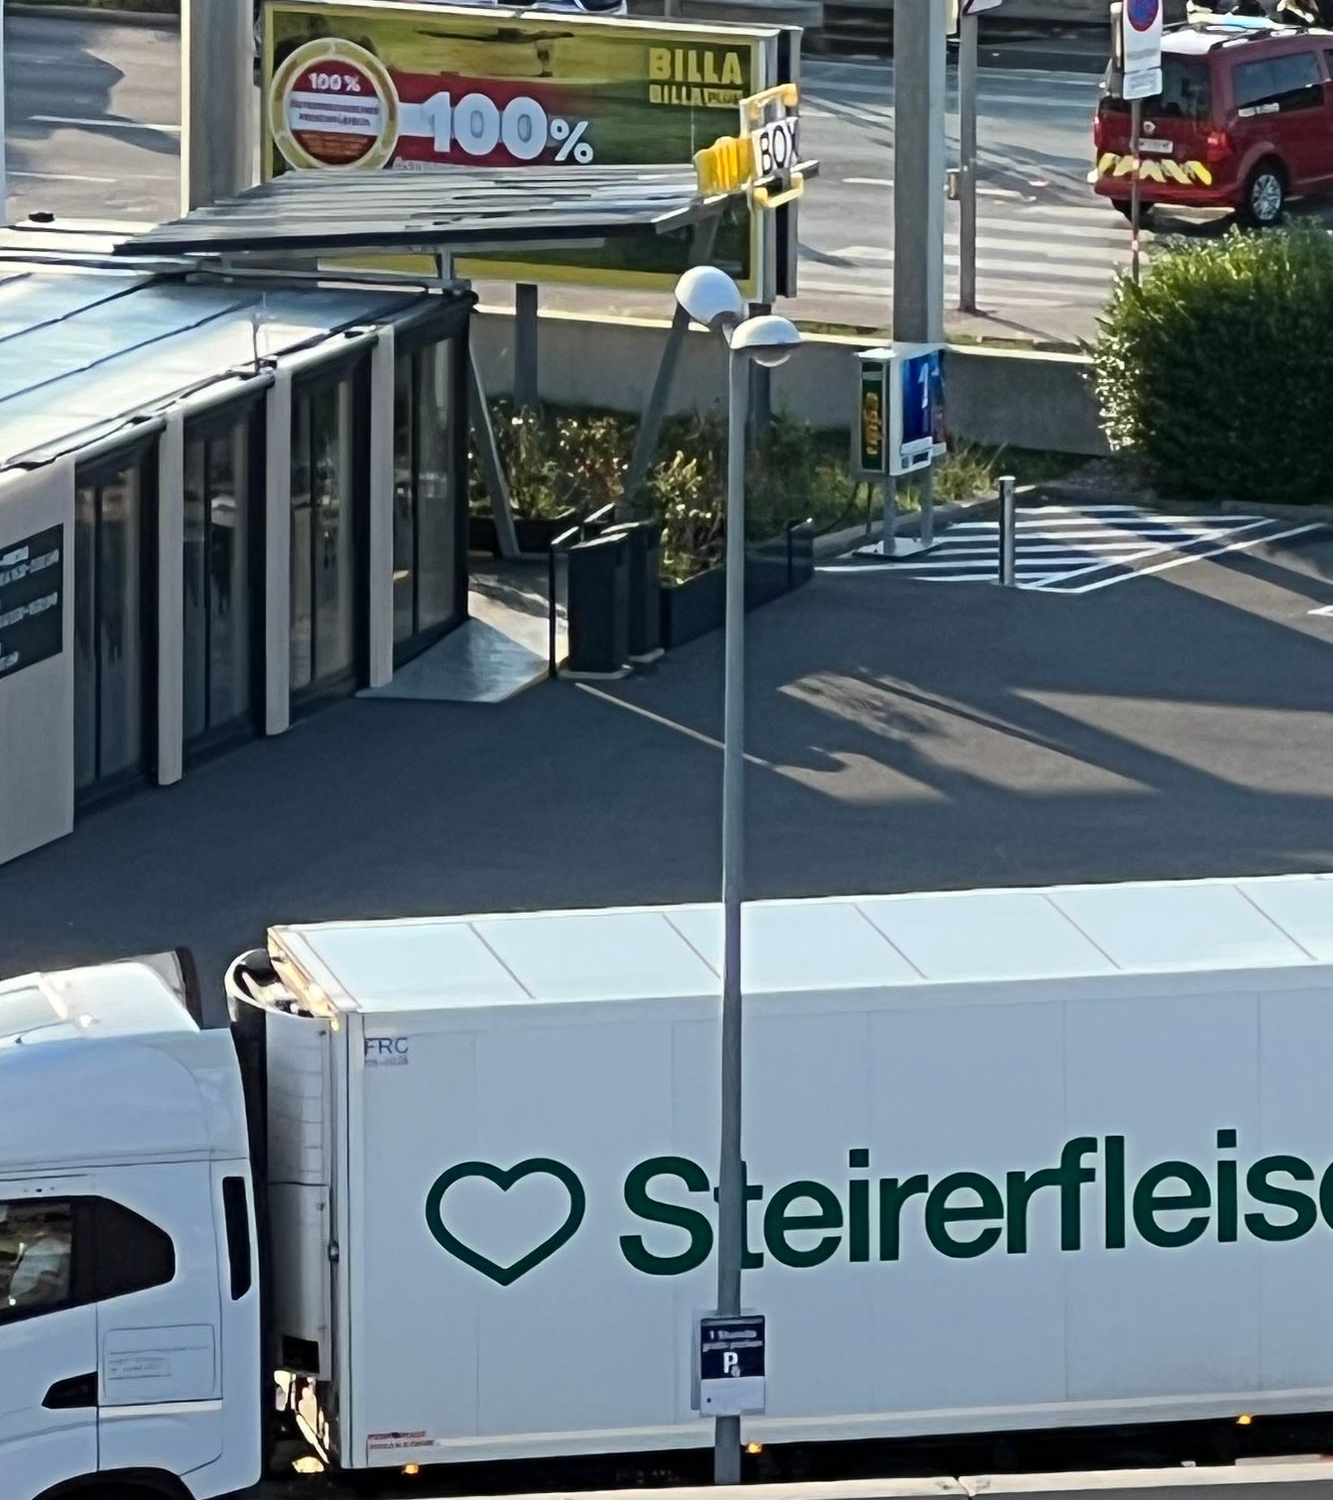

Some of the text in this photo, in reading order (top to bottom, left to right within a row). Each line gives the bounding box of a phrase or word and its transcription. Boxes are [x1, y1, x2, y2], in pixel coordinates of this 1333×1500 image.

[650, 48, 742, 85] BILLA
[650, 84, 703, 107] BILLA
[759, 124, 799, 175] BOX
[364, 1037, 409, 1056] FRC
[723, 1351, 739, 1374] P
